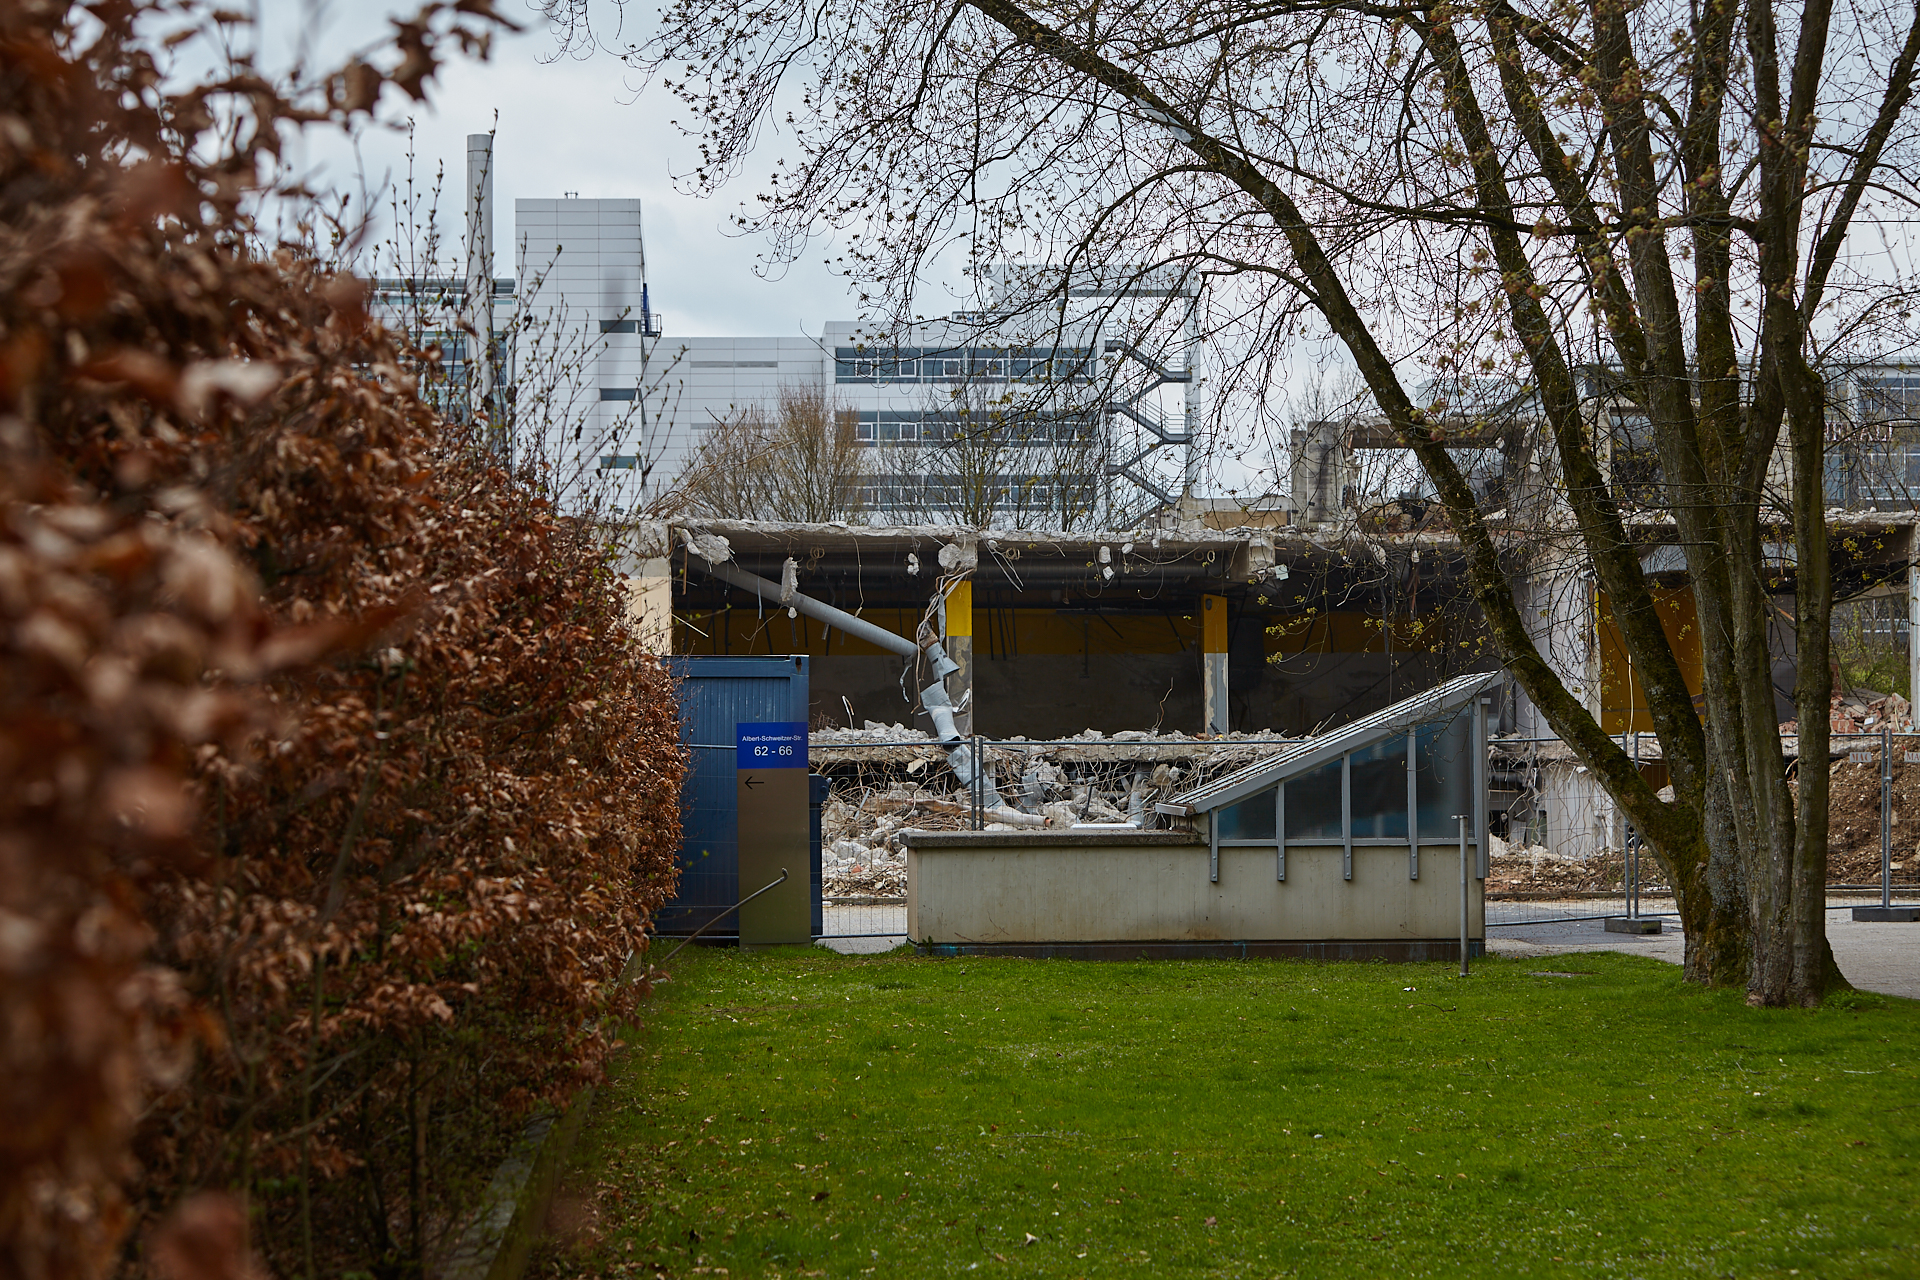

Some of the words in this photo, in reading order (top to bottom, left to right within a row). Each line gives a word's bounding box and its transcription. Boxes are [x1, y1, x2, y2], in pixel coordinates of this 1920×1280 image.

[754, 746, 769, 756] 62
[778, 745, 793, 756] 66
[1906, 752, 1920, 761] MA
